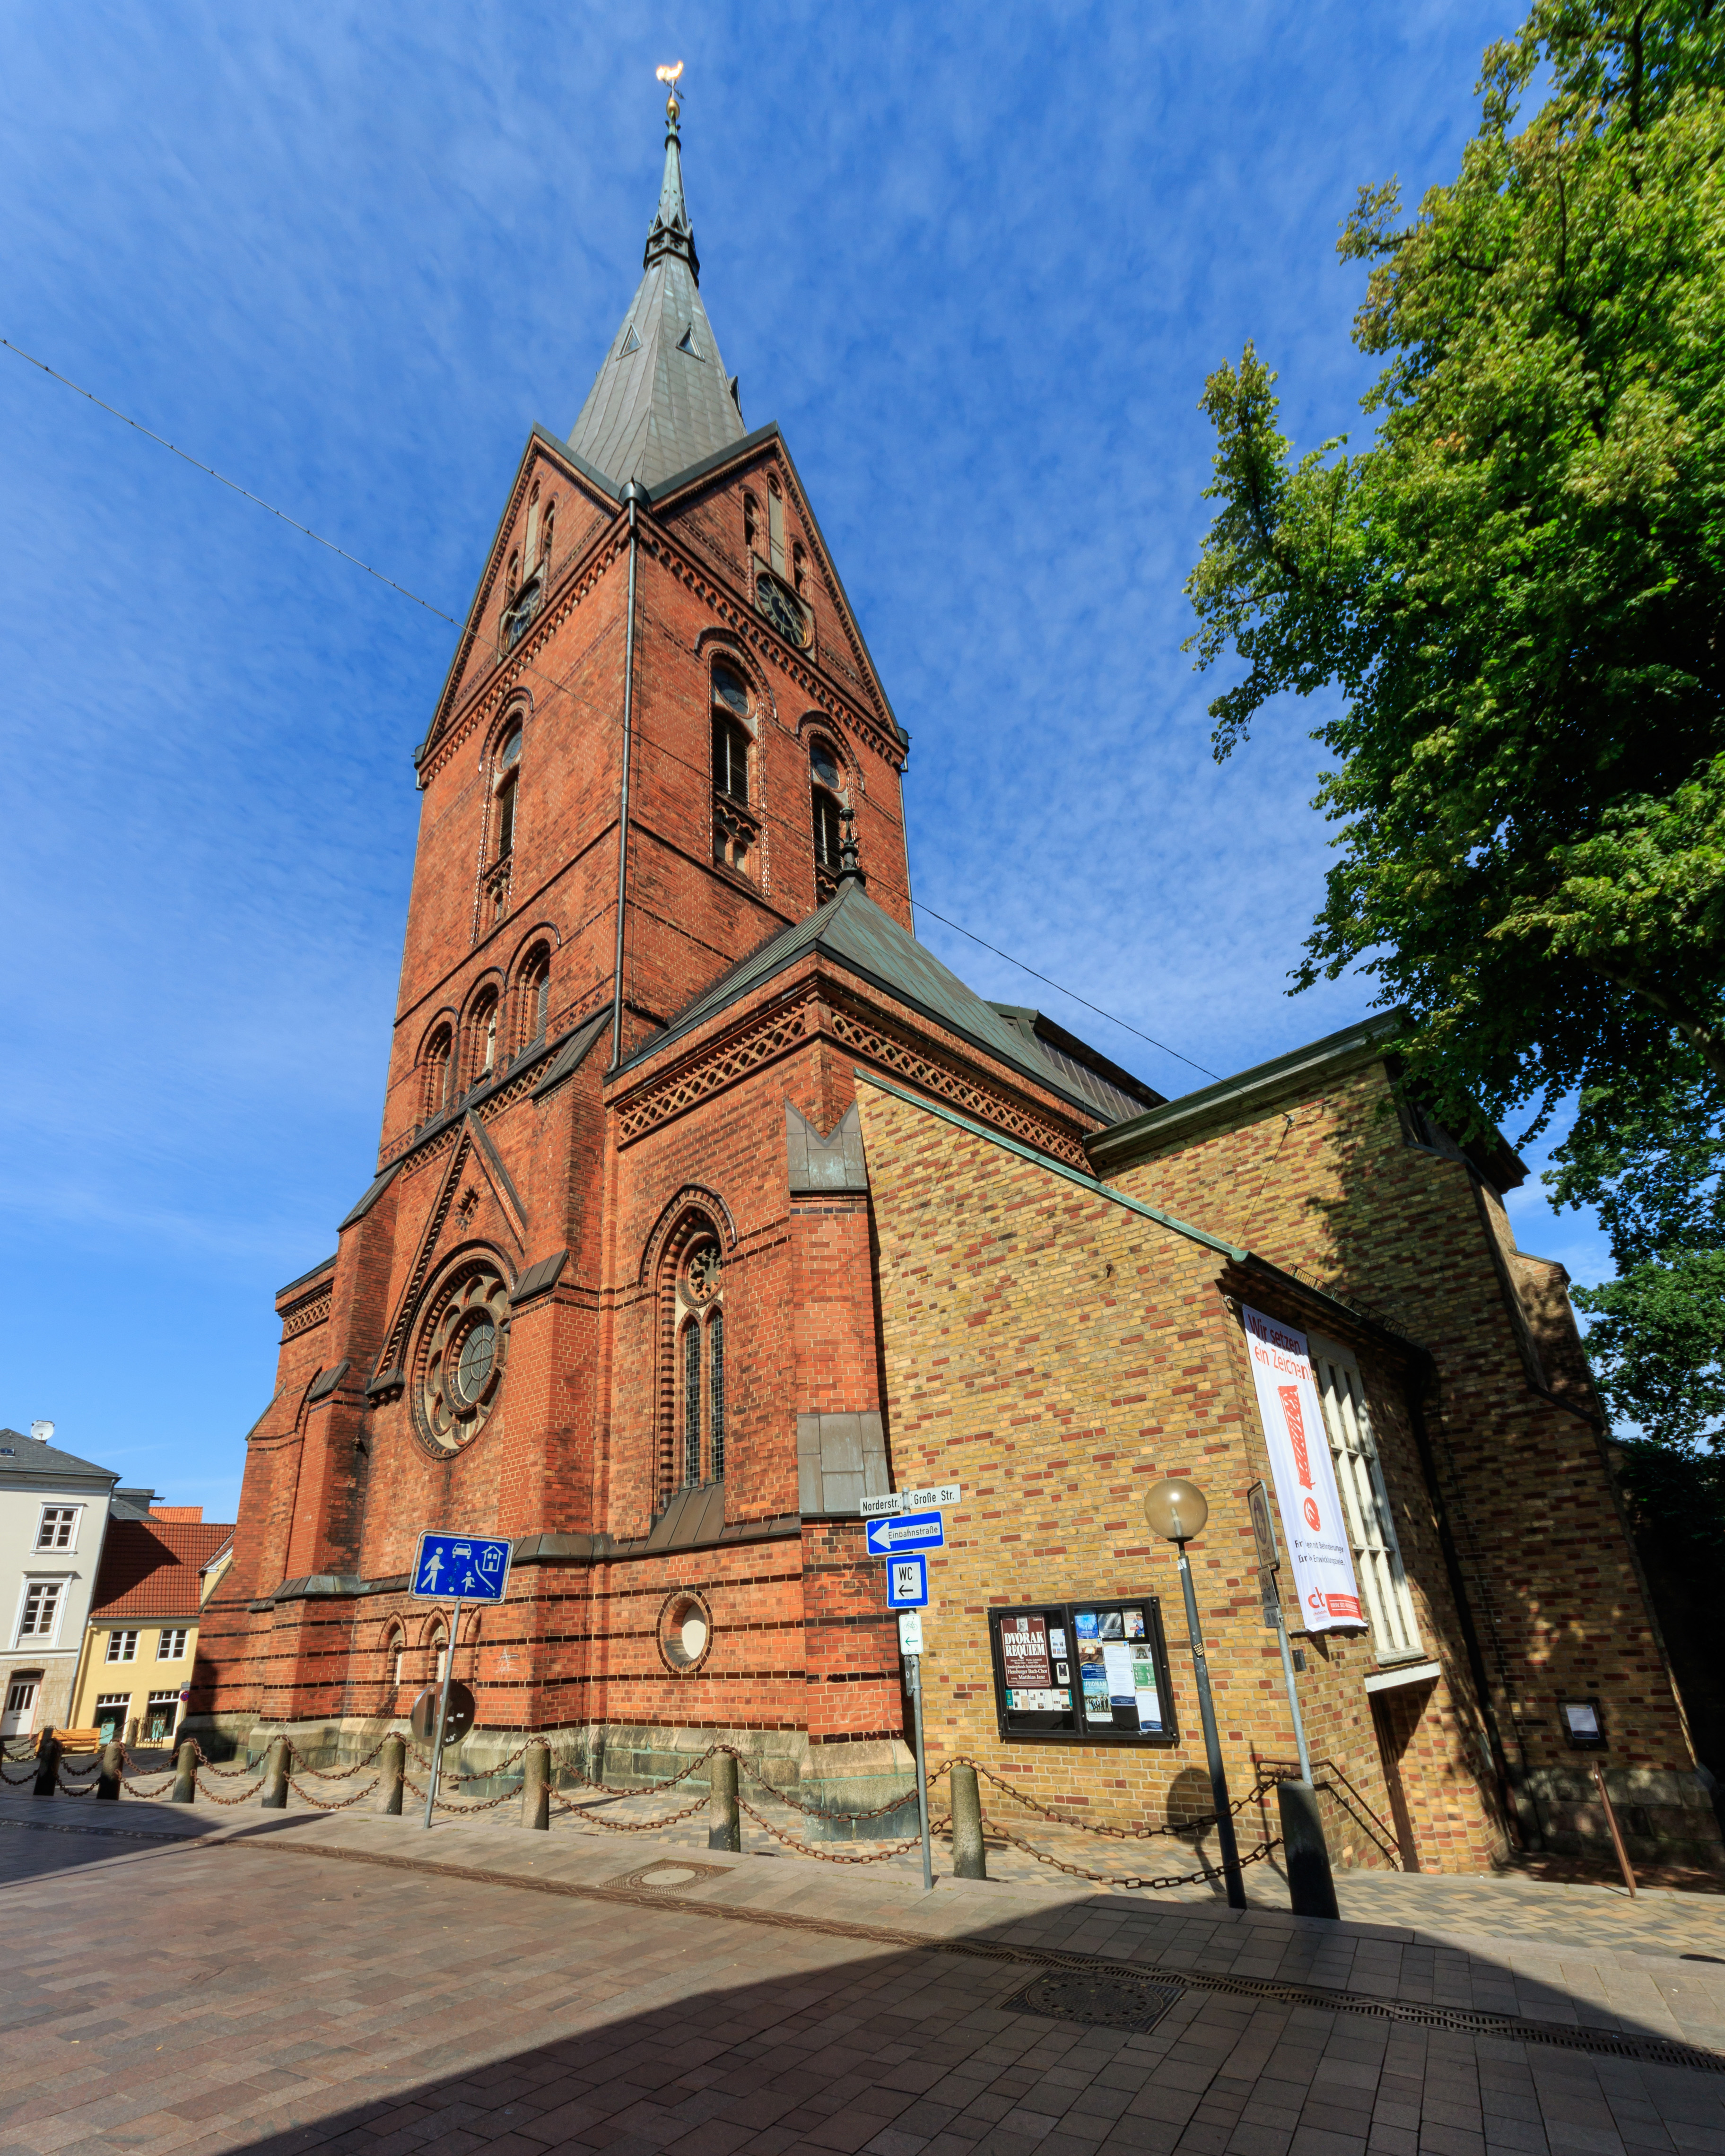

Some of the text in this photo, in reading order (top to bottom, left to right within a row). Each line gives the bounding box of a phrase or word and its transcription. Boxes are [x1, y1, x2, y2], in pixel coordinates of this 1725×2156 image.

[1247, 1314, 1301, 1355] Wir setzen
[1255, 1342, 1313, 1381] ein Zeichen!
[914, 1490, 955, 1504] Große Str.
[862, 1498, 899, 1512] Norderstr.
[888, 1526, 938, 1539] Einbahnstraße
[898, 1566, 913, 1581] WC
[1004, 1632, 1045, 1644] DVORAK
[1005, 1643, 1045, 1659] REQUIEM
